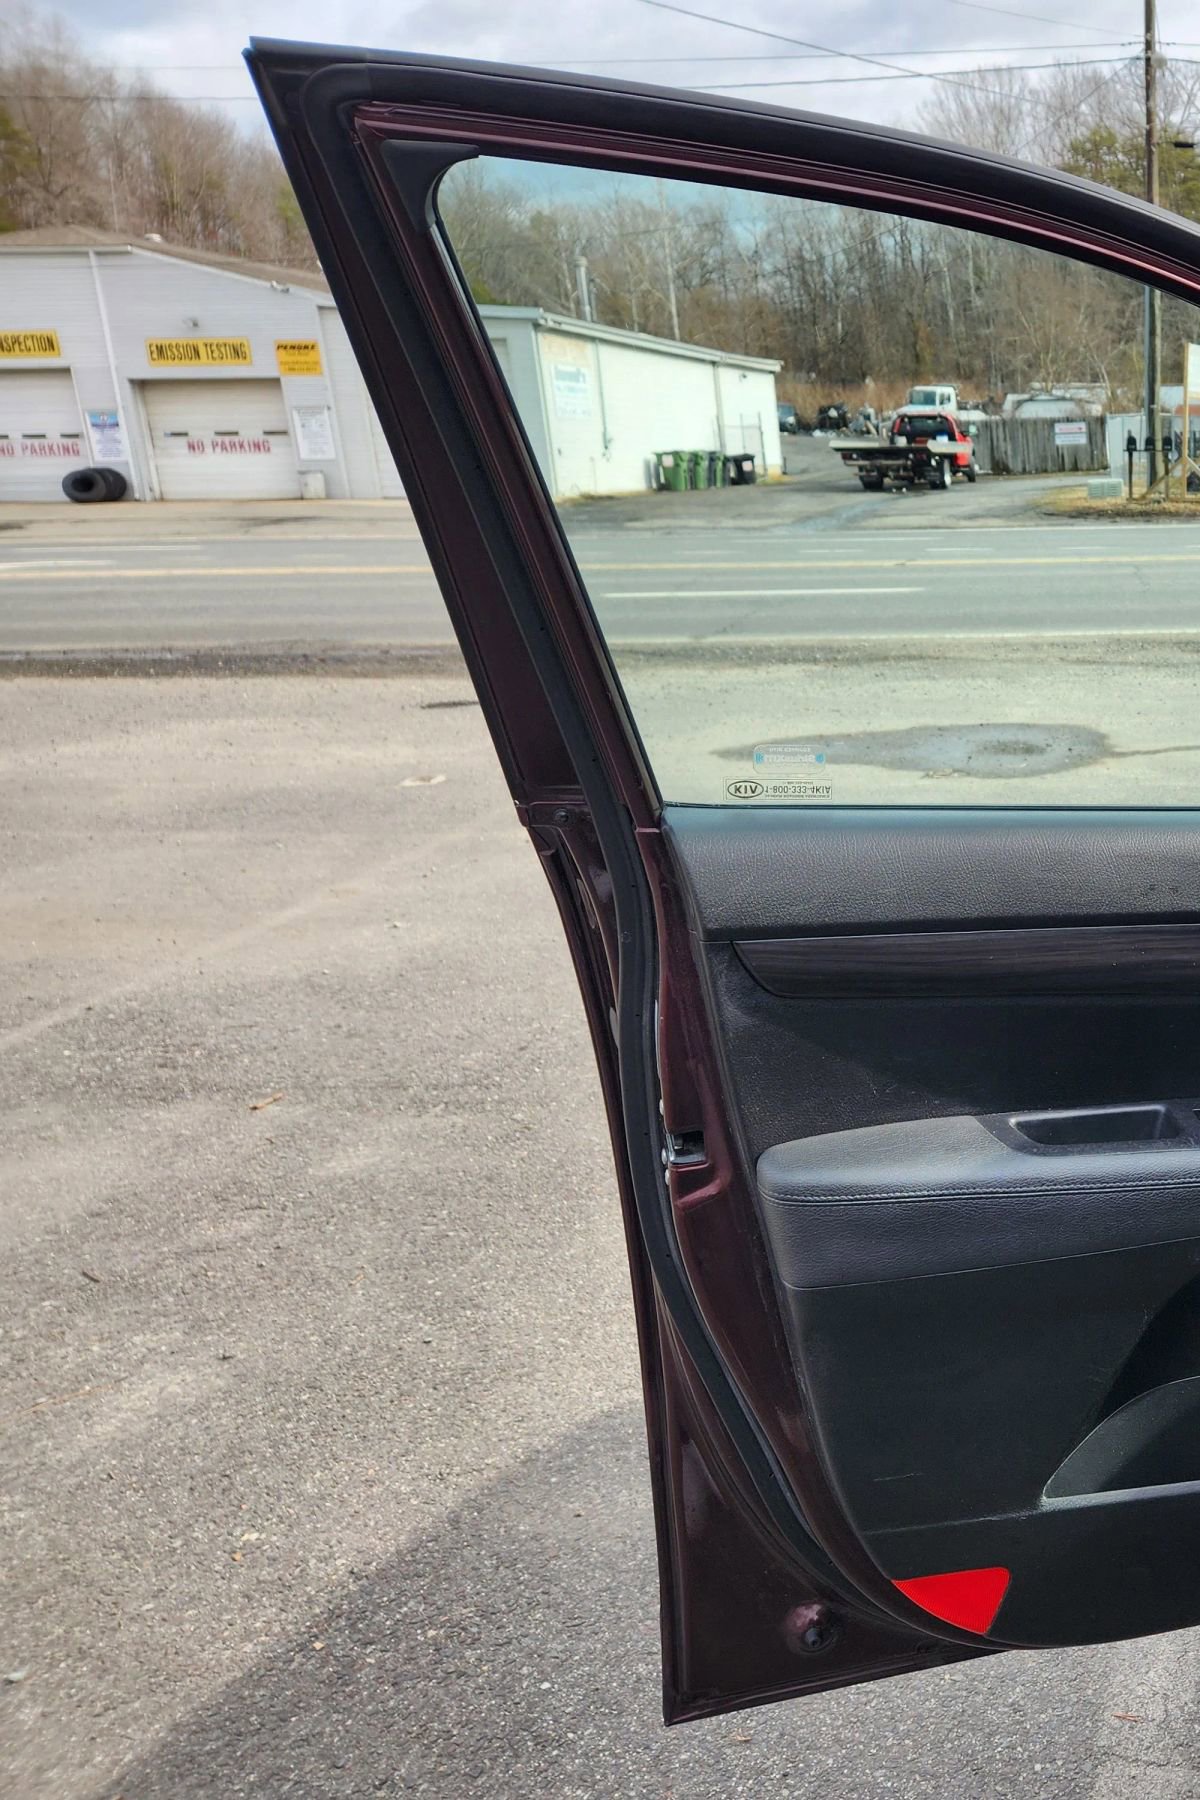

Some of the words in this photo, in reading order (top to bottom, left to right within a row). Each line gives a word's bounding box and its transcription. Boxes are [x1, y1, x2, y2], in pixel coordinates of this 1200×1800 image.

[149, 342, 200, 361] EMISSION
[203, 341, 247, 361] TESTING
[21, 441, 80, 456] PARKING
[187, 440, 205, 454] NO
[211, 439, 270, 453] PARKING
